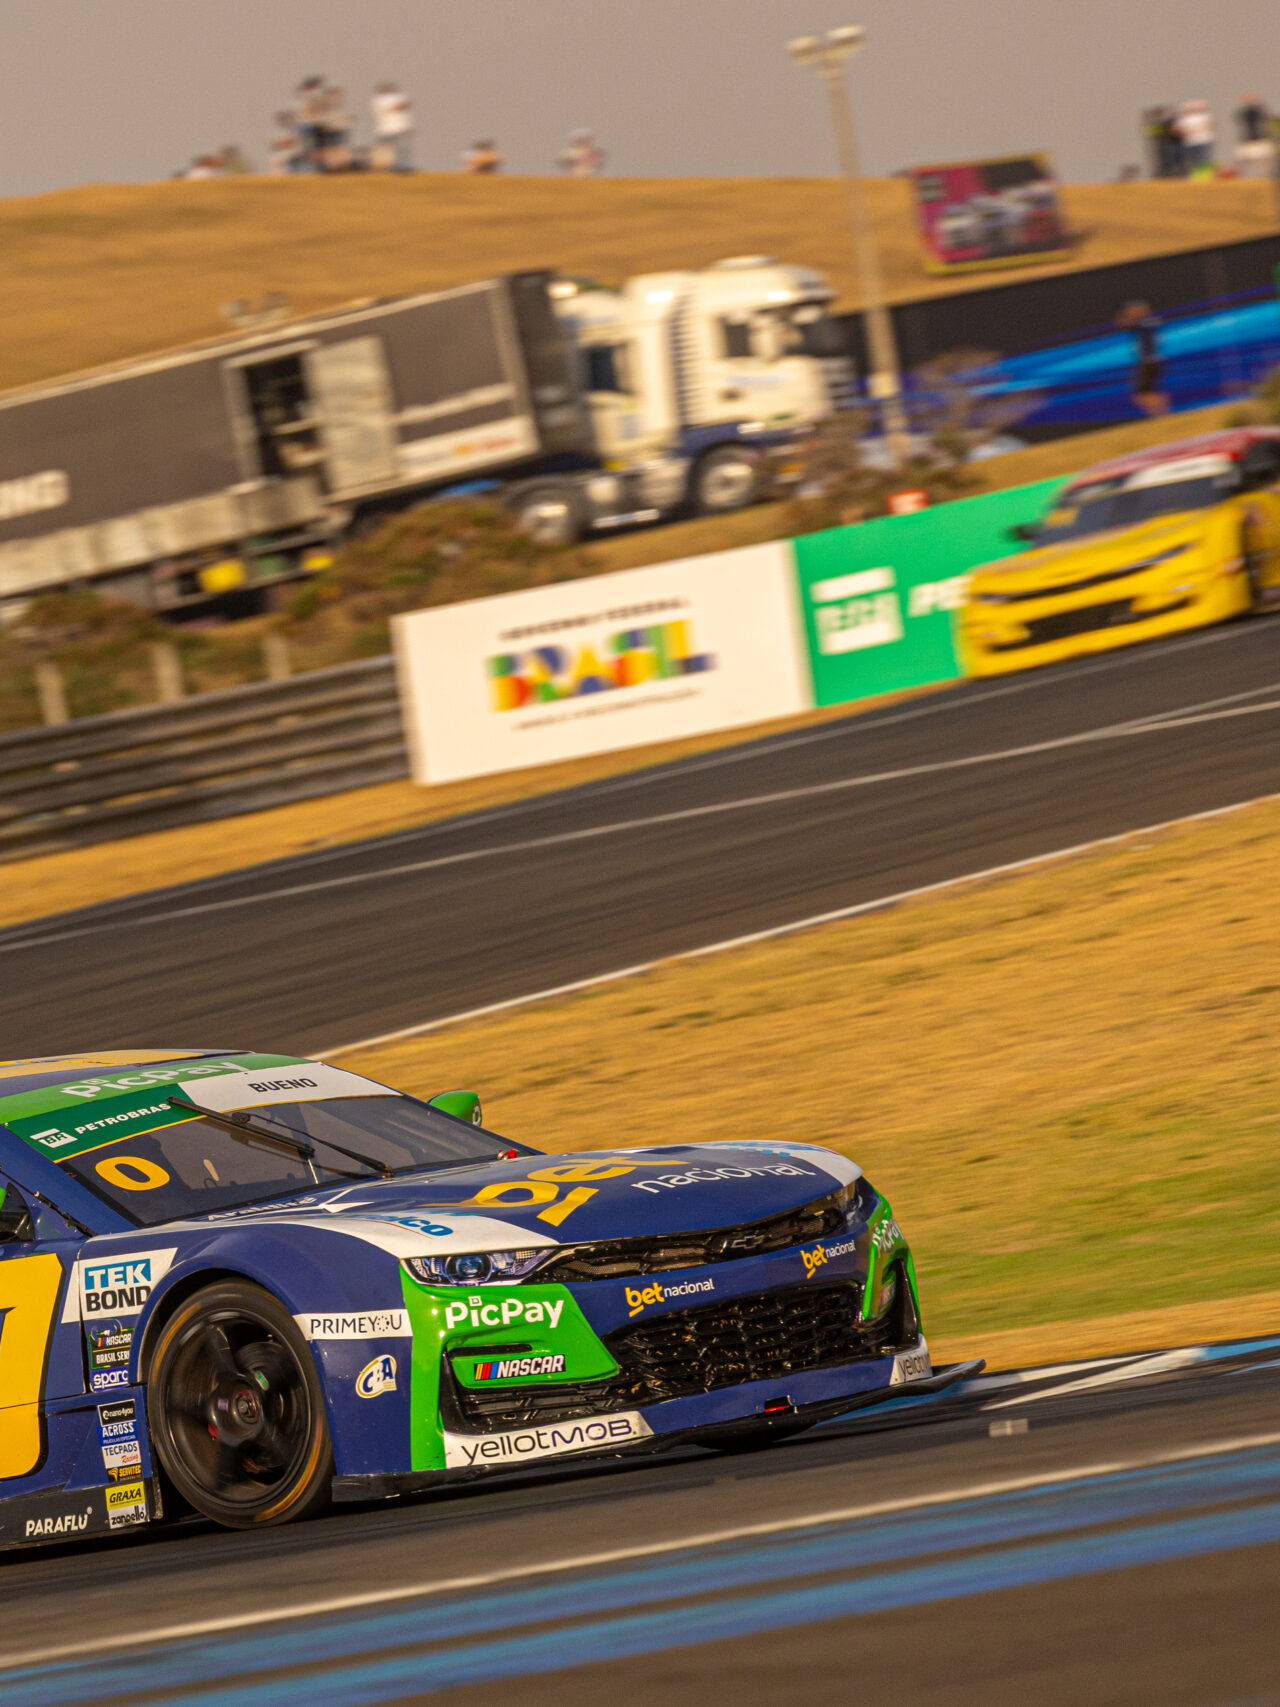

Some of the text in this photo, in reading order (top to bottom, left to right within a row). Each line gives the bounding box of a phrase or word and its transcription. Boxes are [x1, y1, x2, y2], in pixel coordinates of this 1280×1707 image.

[485, 619, 719, 713] BRASIL
[60, 1062, 249, 1097] PicPay
[248, 1078, 318, 1093] BUENO
[74, 1102, 171, 1134] PETROBRAS
[95, 1156, 170, 1191] 0
[631, 1163, 817, 1194] nacional
[800, 1240, 856, 1271] bet nacional
[88, 1263, 148, 1288] TEK
[86, 1286, 151, 1312] BOND
[625, 1278, 714, 1308] bet nacional
[445, 1296, 564, 1329] PicPay
[106, 1333, 131, 1346] NASCAR
[96, 1351, 130, 1364] BRASIL SERI
[496, 1355, 565, 1378] NASCAR
[94, 1370, 128, 1388] sparc
[102, 1422, 134, 1437] ACROSS
[462, 1419, 632, 1464] yellotMOB
[104, 1443, 137, 1456] TECPADS
[109, 1488, 142, 1503] GRAXA
[26, 1511, 88, 1536] PARAFLU
